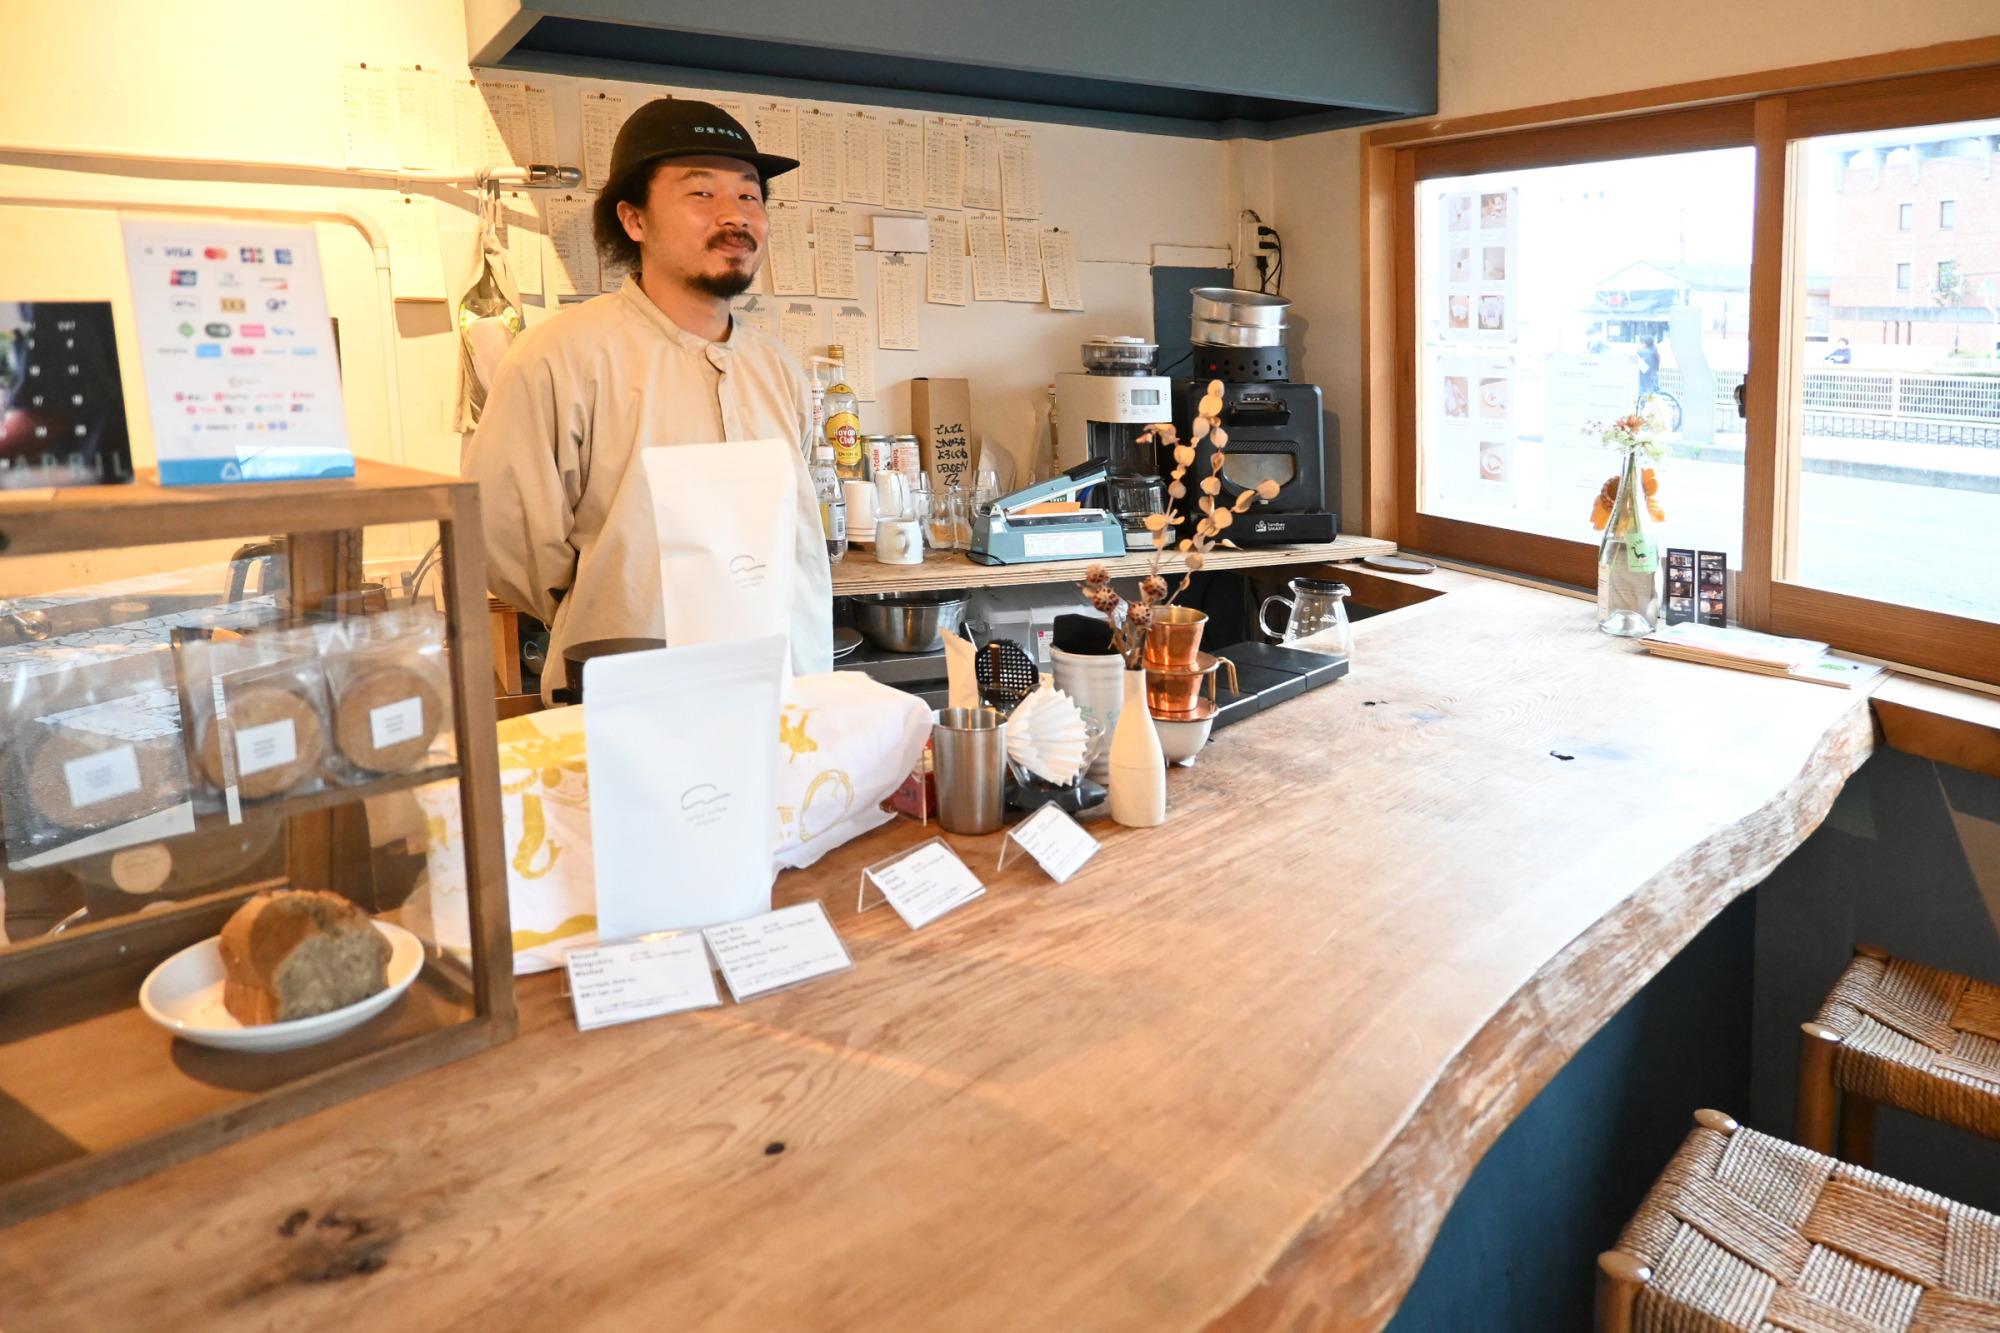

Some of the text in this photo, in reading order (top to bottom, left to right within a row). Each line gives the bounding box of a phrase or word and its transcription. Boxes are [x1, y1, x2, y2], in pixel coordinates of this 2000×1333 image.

[164, 247, 193, 258] VISA
[934, 423, 964, 435] でんでん
[839, 436, 855, 445] Club
[937, 448, 968, 460] よろしくね
[15, 451, 126, 478] APRIL
